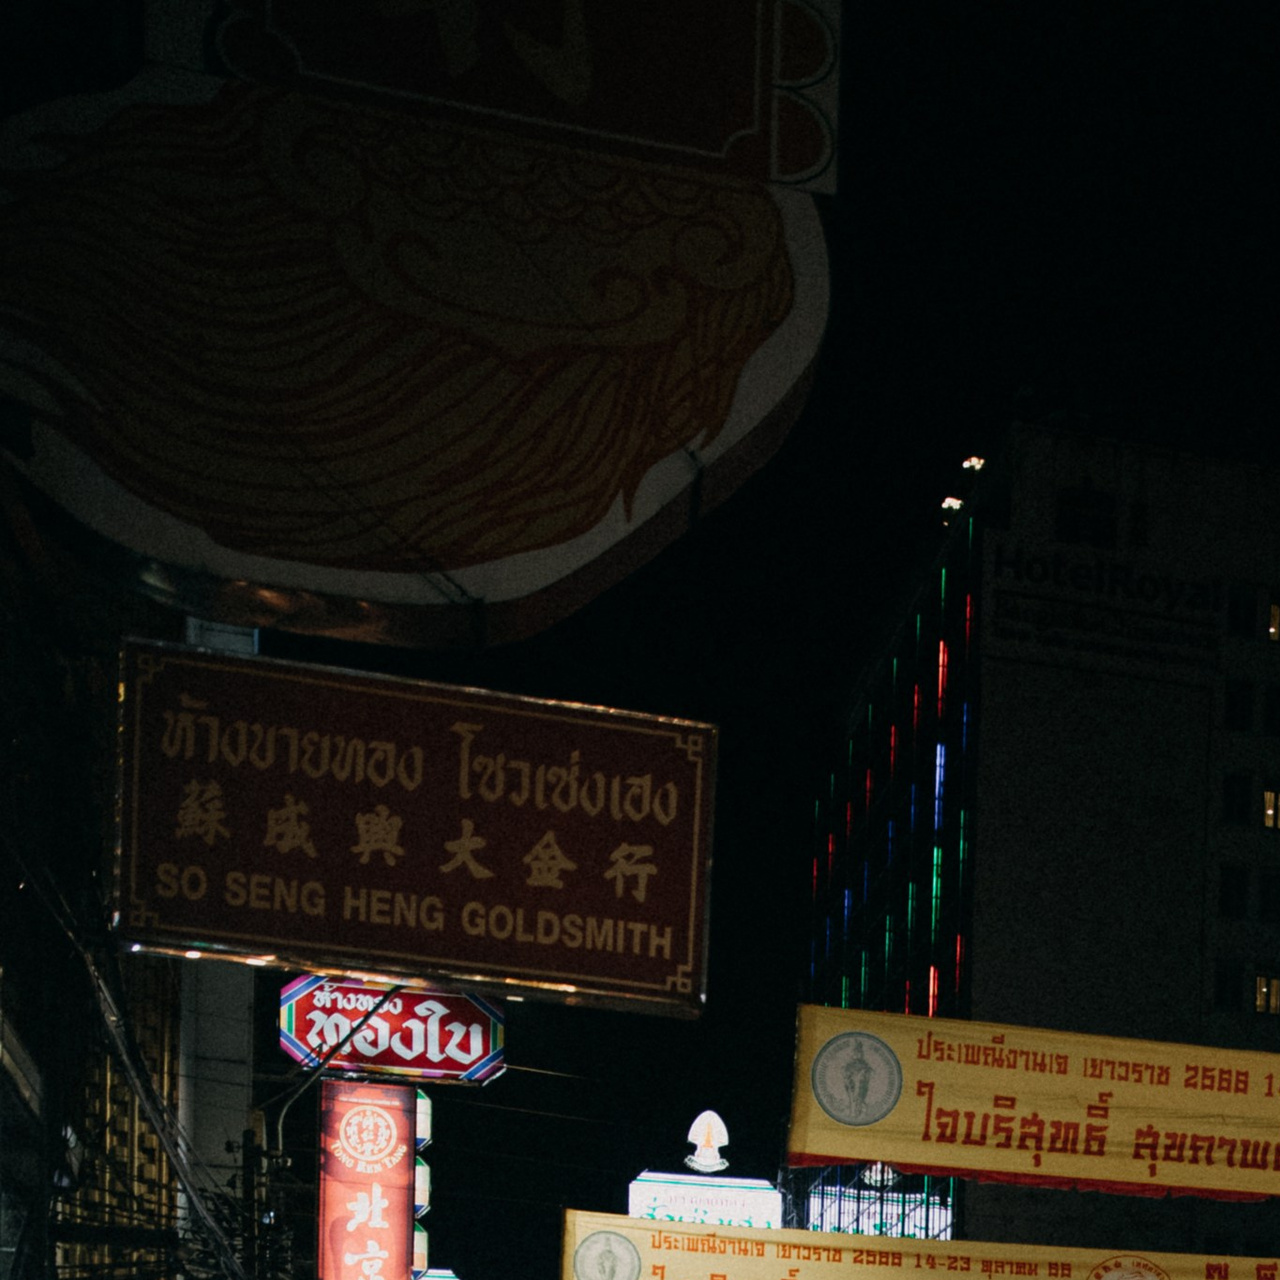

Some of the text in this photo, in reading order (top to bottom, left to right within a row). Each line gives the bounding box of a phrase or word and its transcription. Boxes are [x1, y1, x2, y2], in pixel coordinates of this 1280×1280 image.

[155, 862, 673, 961] SO SENG HENG GOLDSMITH
[305, 1000, 484, 1065] ทองใบ
[916, 1031, 1069, 1076] ประเพณีงานเจ
[1083, 1056, 1170, 1086] เยาวราช
[1184, 1063, 1250, 1095] 2566
[916, 1080, 1114, 1168] ใจบริสุทธิ์
[331, 1140, 408, 1174] TONG REN TANG
[776, 1242, 843, 1263] เยาวราช
[852, 1249, 902, 1268] 2566
[914, 1254, 972, 1273] 14-23
[981, 1260, 1039, 1280] ตุลาคม
[1047, 1262, 1073, 1279] 66
